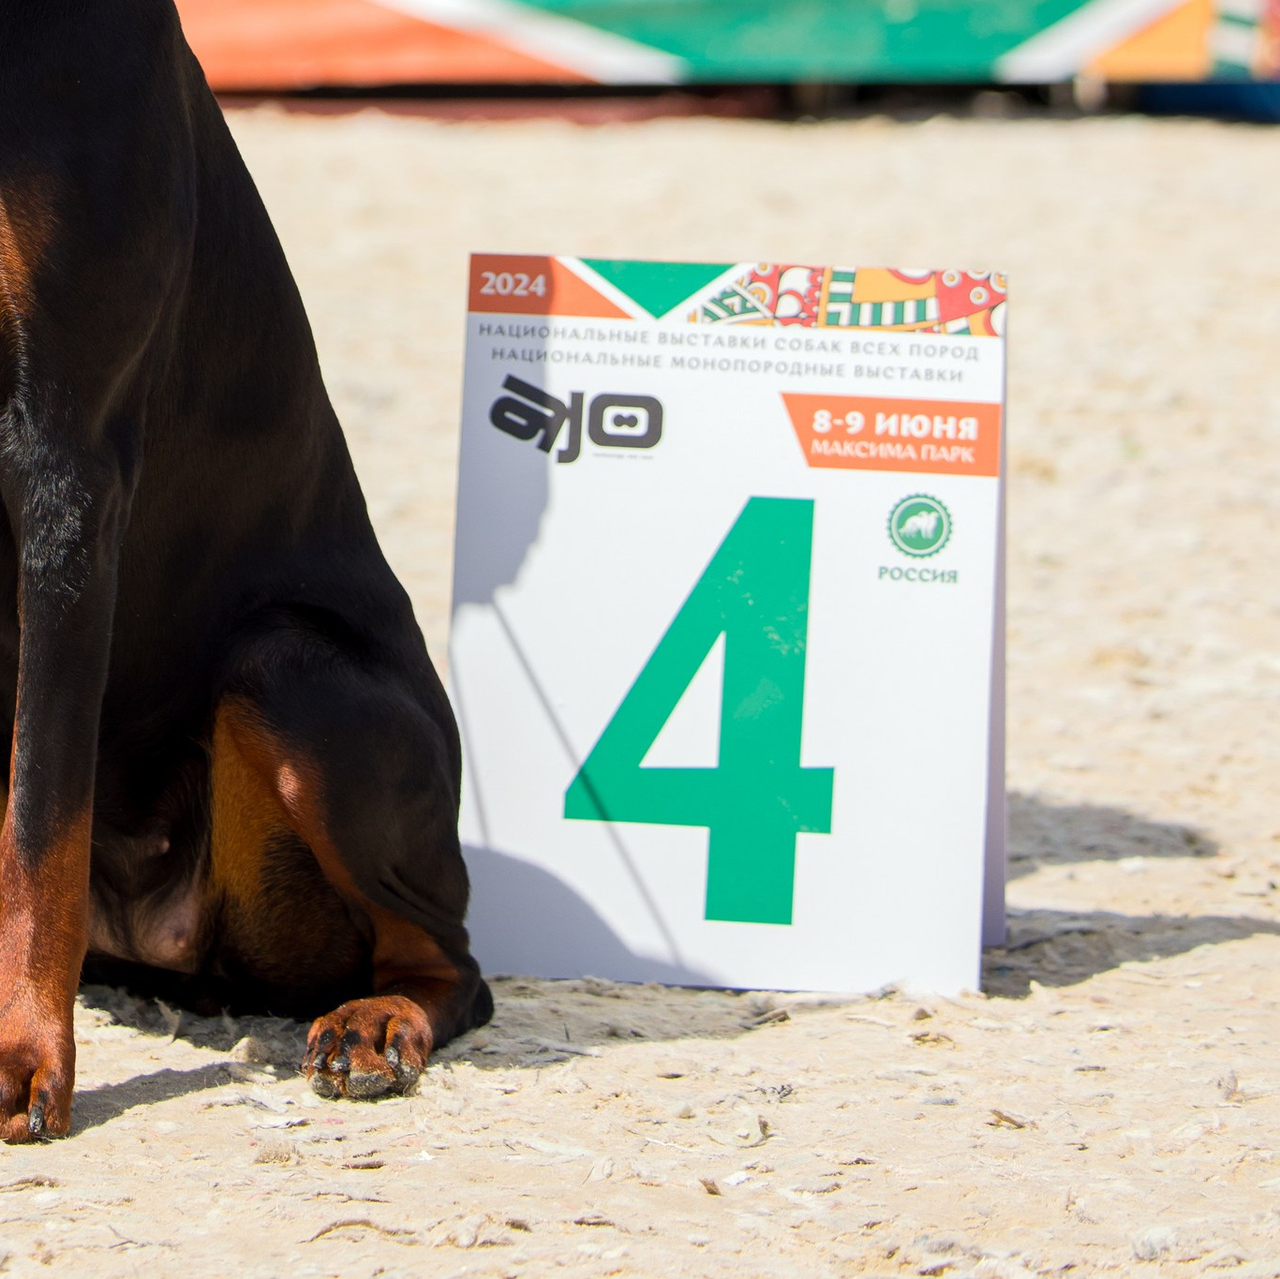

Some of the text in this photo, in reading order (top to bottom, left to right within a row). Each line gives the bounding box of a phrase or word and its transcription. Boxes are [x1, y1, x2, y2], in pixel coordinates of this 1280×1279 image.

[480, 271, 546, 297] 2024
[478, 323, 980, 361] НАЦИОНАЛЬНЫЕ ВЫСТАВКИ СОБАК ВСЕХ ПОРОД
[491, 347, 964, 383] НАЦИОНАЛЬНЫЕ МОНОПОРОДНЫЕ ВЫСТАВКИ
[811, 408, 980, 441] 8-9 ИЮНЯ
[810, 438, 976, 464] МАКСИМА ПАРК
[877, 566, 959, 585] РОССИЯ
[563, 496, 835, 926] 4
